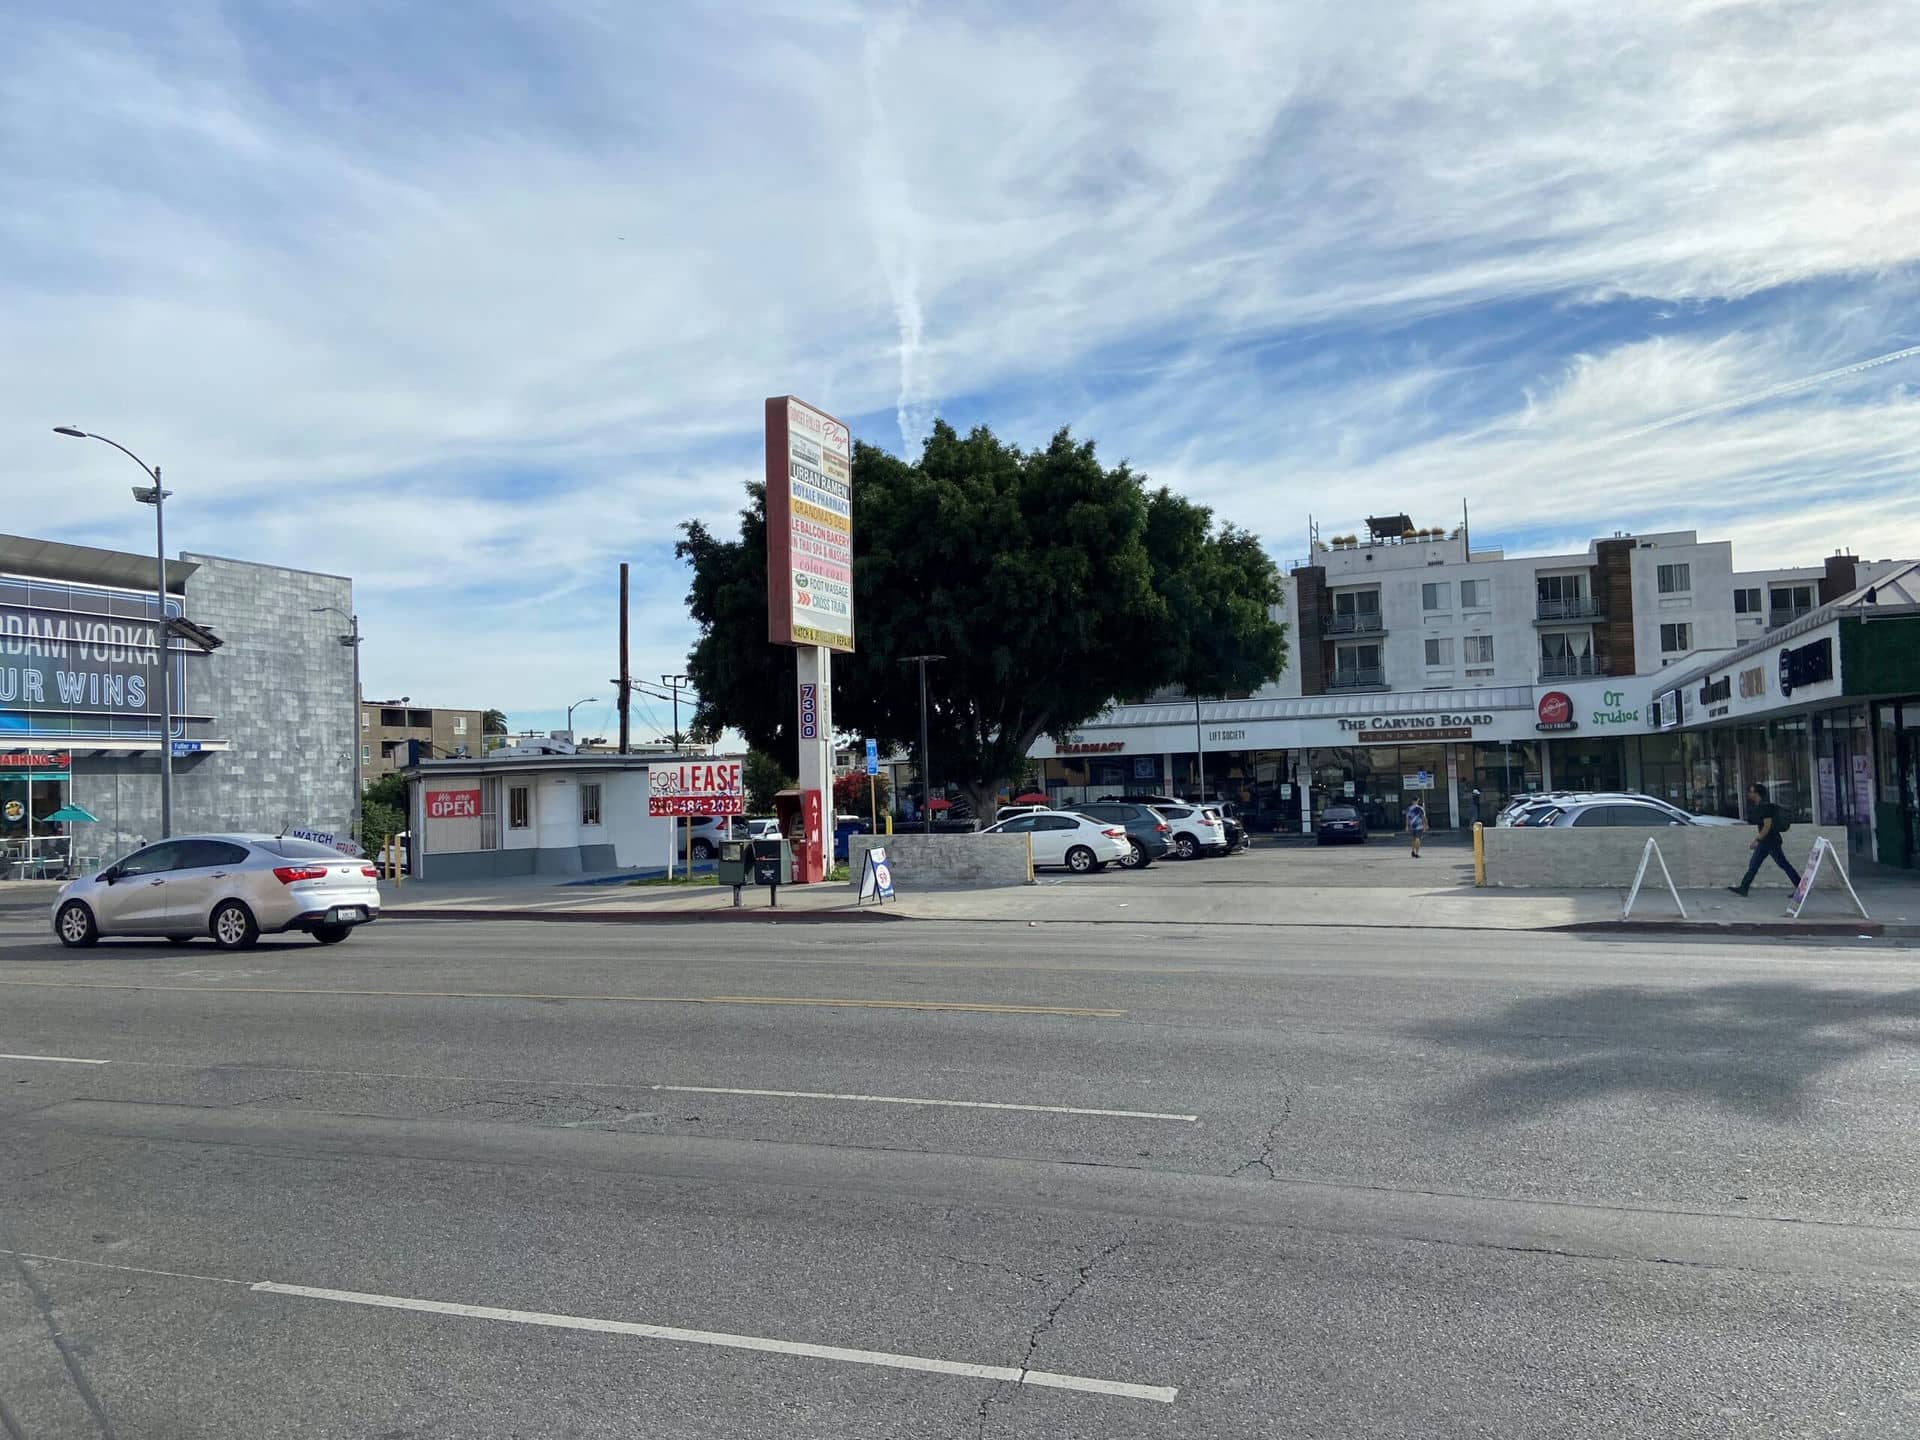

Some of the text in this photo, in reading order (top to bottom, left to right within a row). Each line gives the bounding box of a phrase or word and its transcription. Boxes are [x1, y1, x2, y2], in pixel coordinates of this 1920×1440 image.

[793, 463, 820, 488] URBAN
[821, 475, 846, 499] RAMEN
[792, 517, 848, 549] LE BALCON BAKERY
[809, 576, 848, 597] FOOT MASSAGE
[812, 595, 846, 614] CROSS TRAIN
[75, 621, 159, 665] VODKA
[56, 671, 146, 707] WINS
[1604, 691, 1624, 707] OT
[801, 685, 816, 738] 7300
[1338, 714, 1493, 730] THE CARVING BOARD
[1209, 730, 1245, 741] LIFT SOCIETY
[1055, 742, 1125, 753] PHARMACY
[0, 754, 48, 766] ARKING
[649, 772, 678, 787] FOR
[680, 765, 740, 792] LEASE
[432, 800, 475, 816] OPEN
[811, 795, 819, 843] ATM
[293, 830, 334, 845] WATCH
